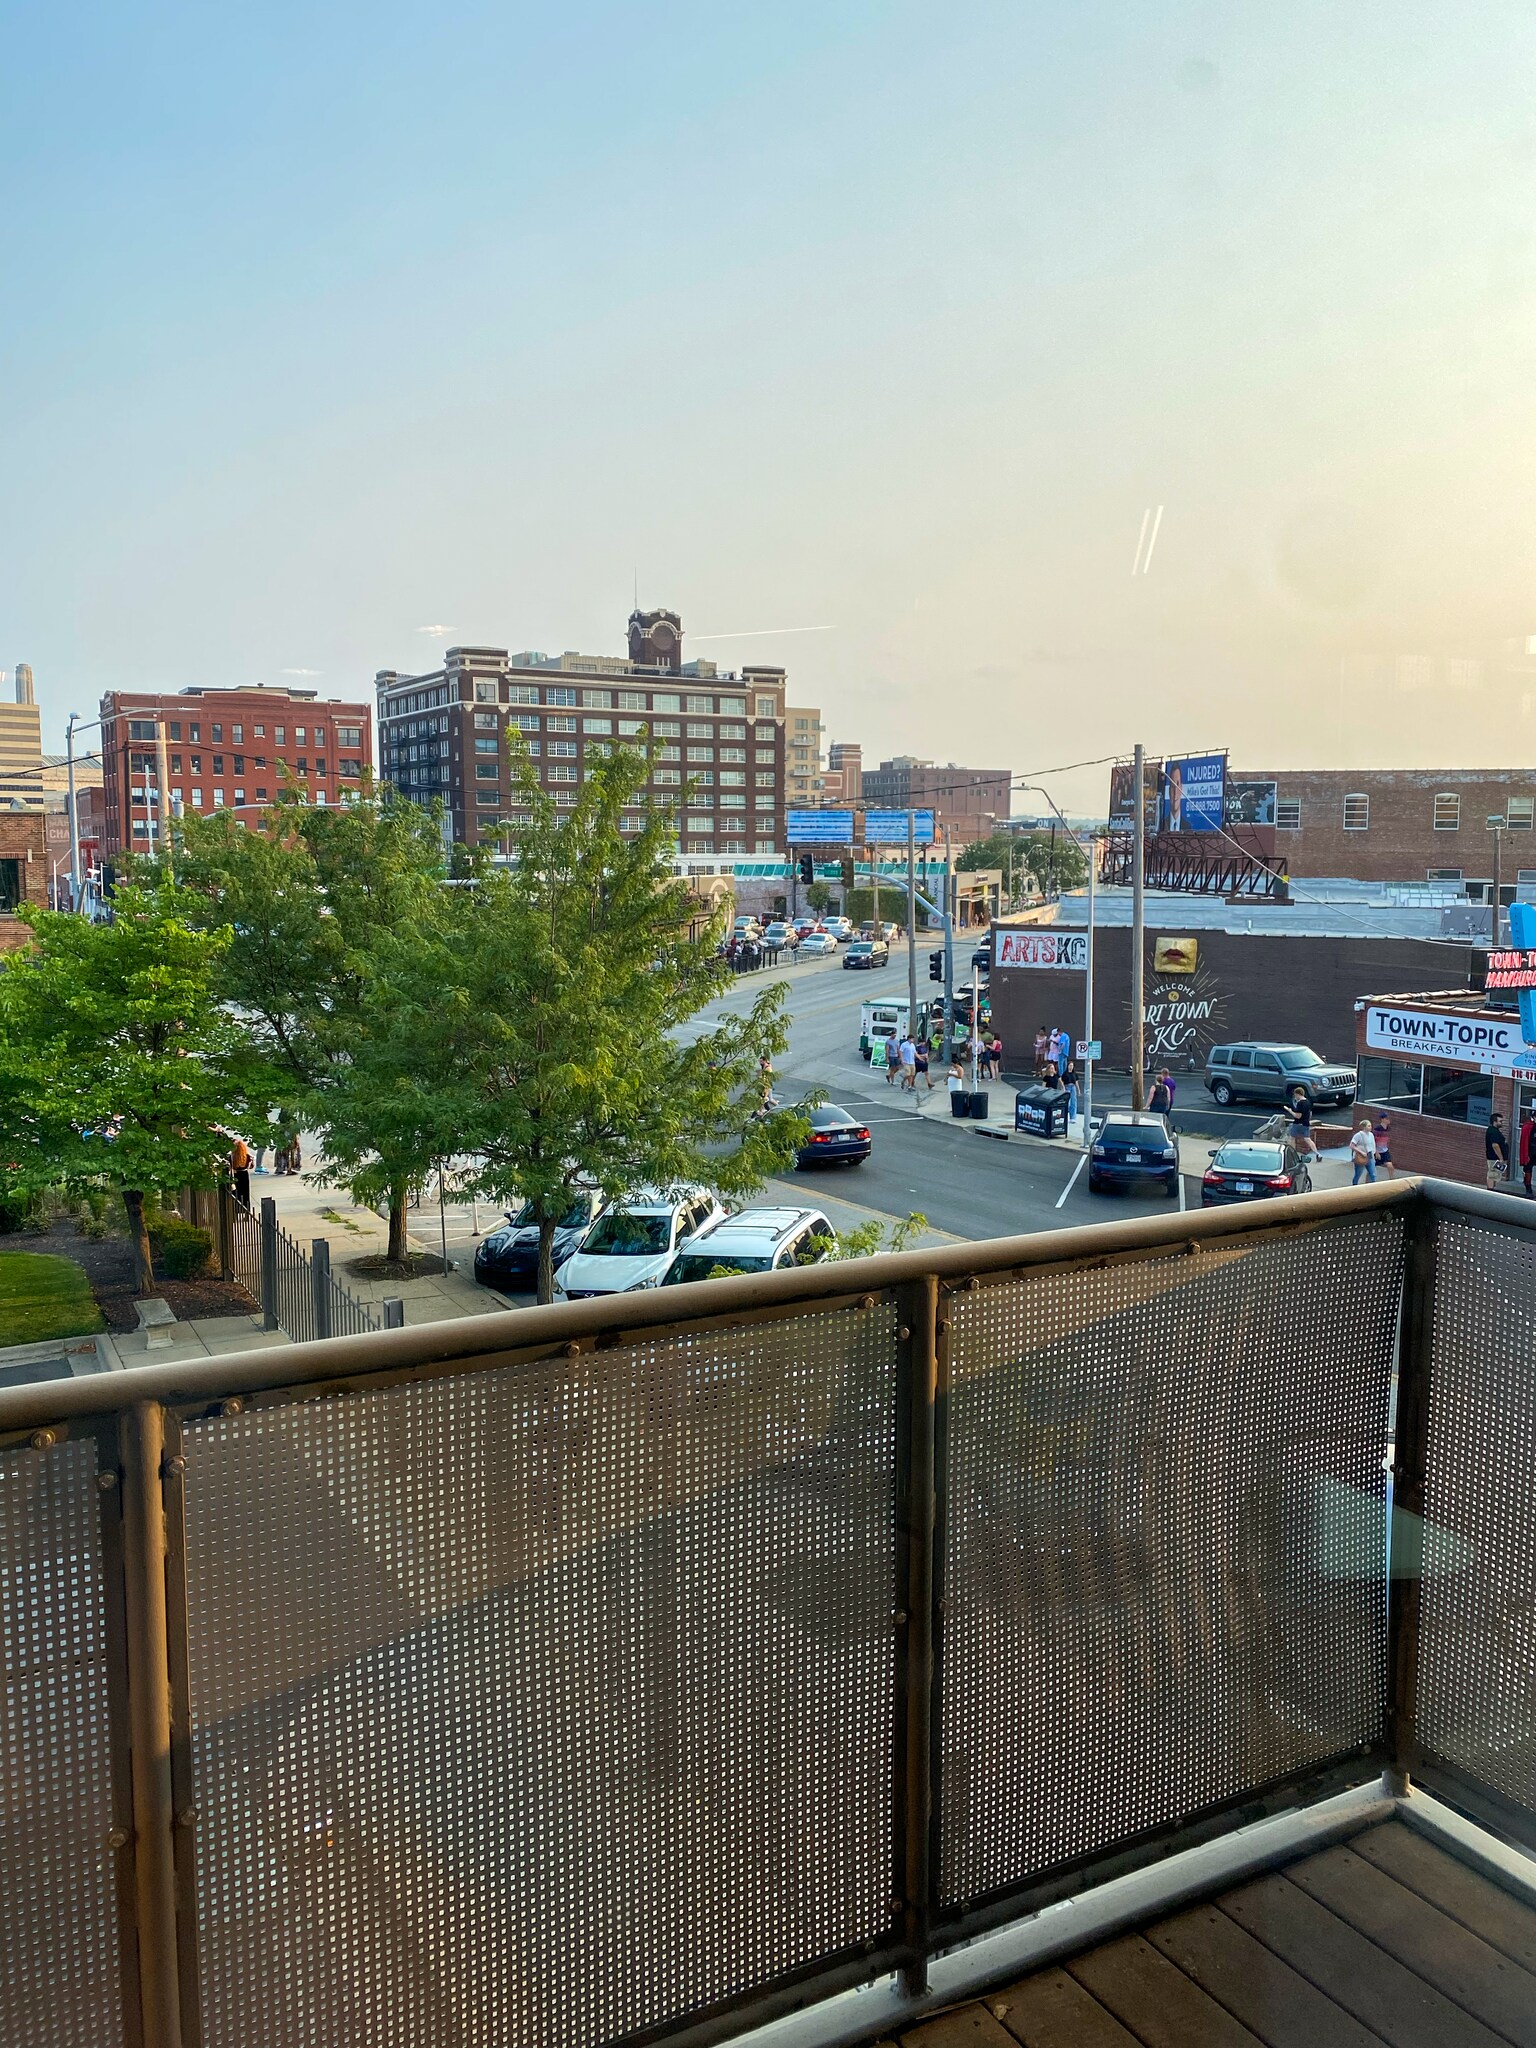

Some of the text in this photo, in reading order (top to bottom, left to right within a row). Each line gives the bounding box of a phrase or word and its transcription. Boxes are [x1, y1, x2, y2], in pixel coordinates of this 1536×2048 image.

[1187, 764, 1221, 781] INJURED?
[1152, 982, 1195, 997] WELCOME
[1167, 998, 1218, 1021] TOWN
[1148, 1022, 1196, 1054] KC
[1391, 1039, 1460, 1056] BREAKFAST
